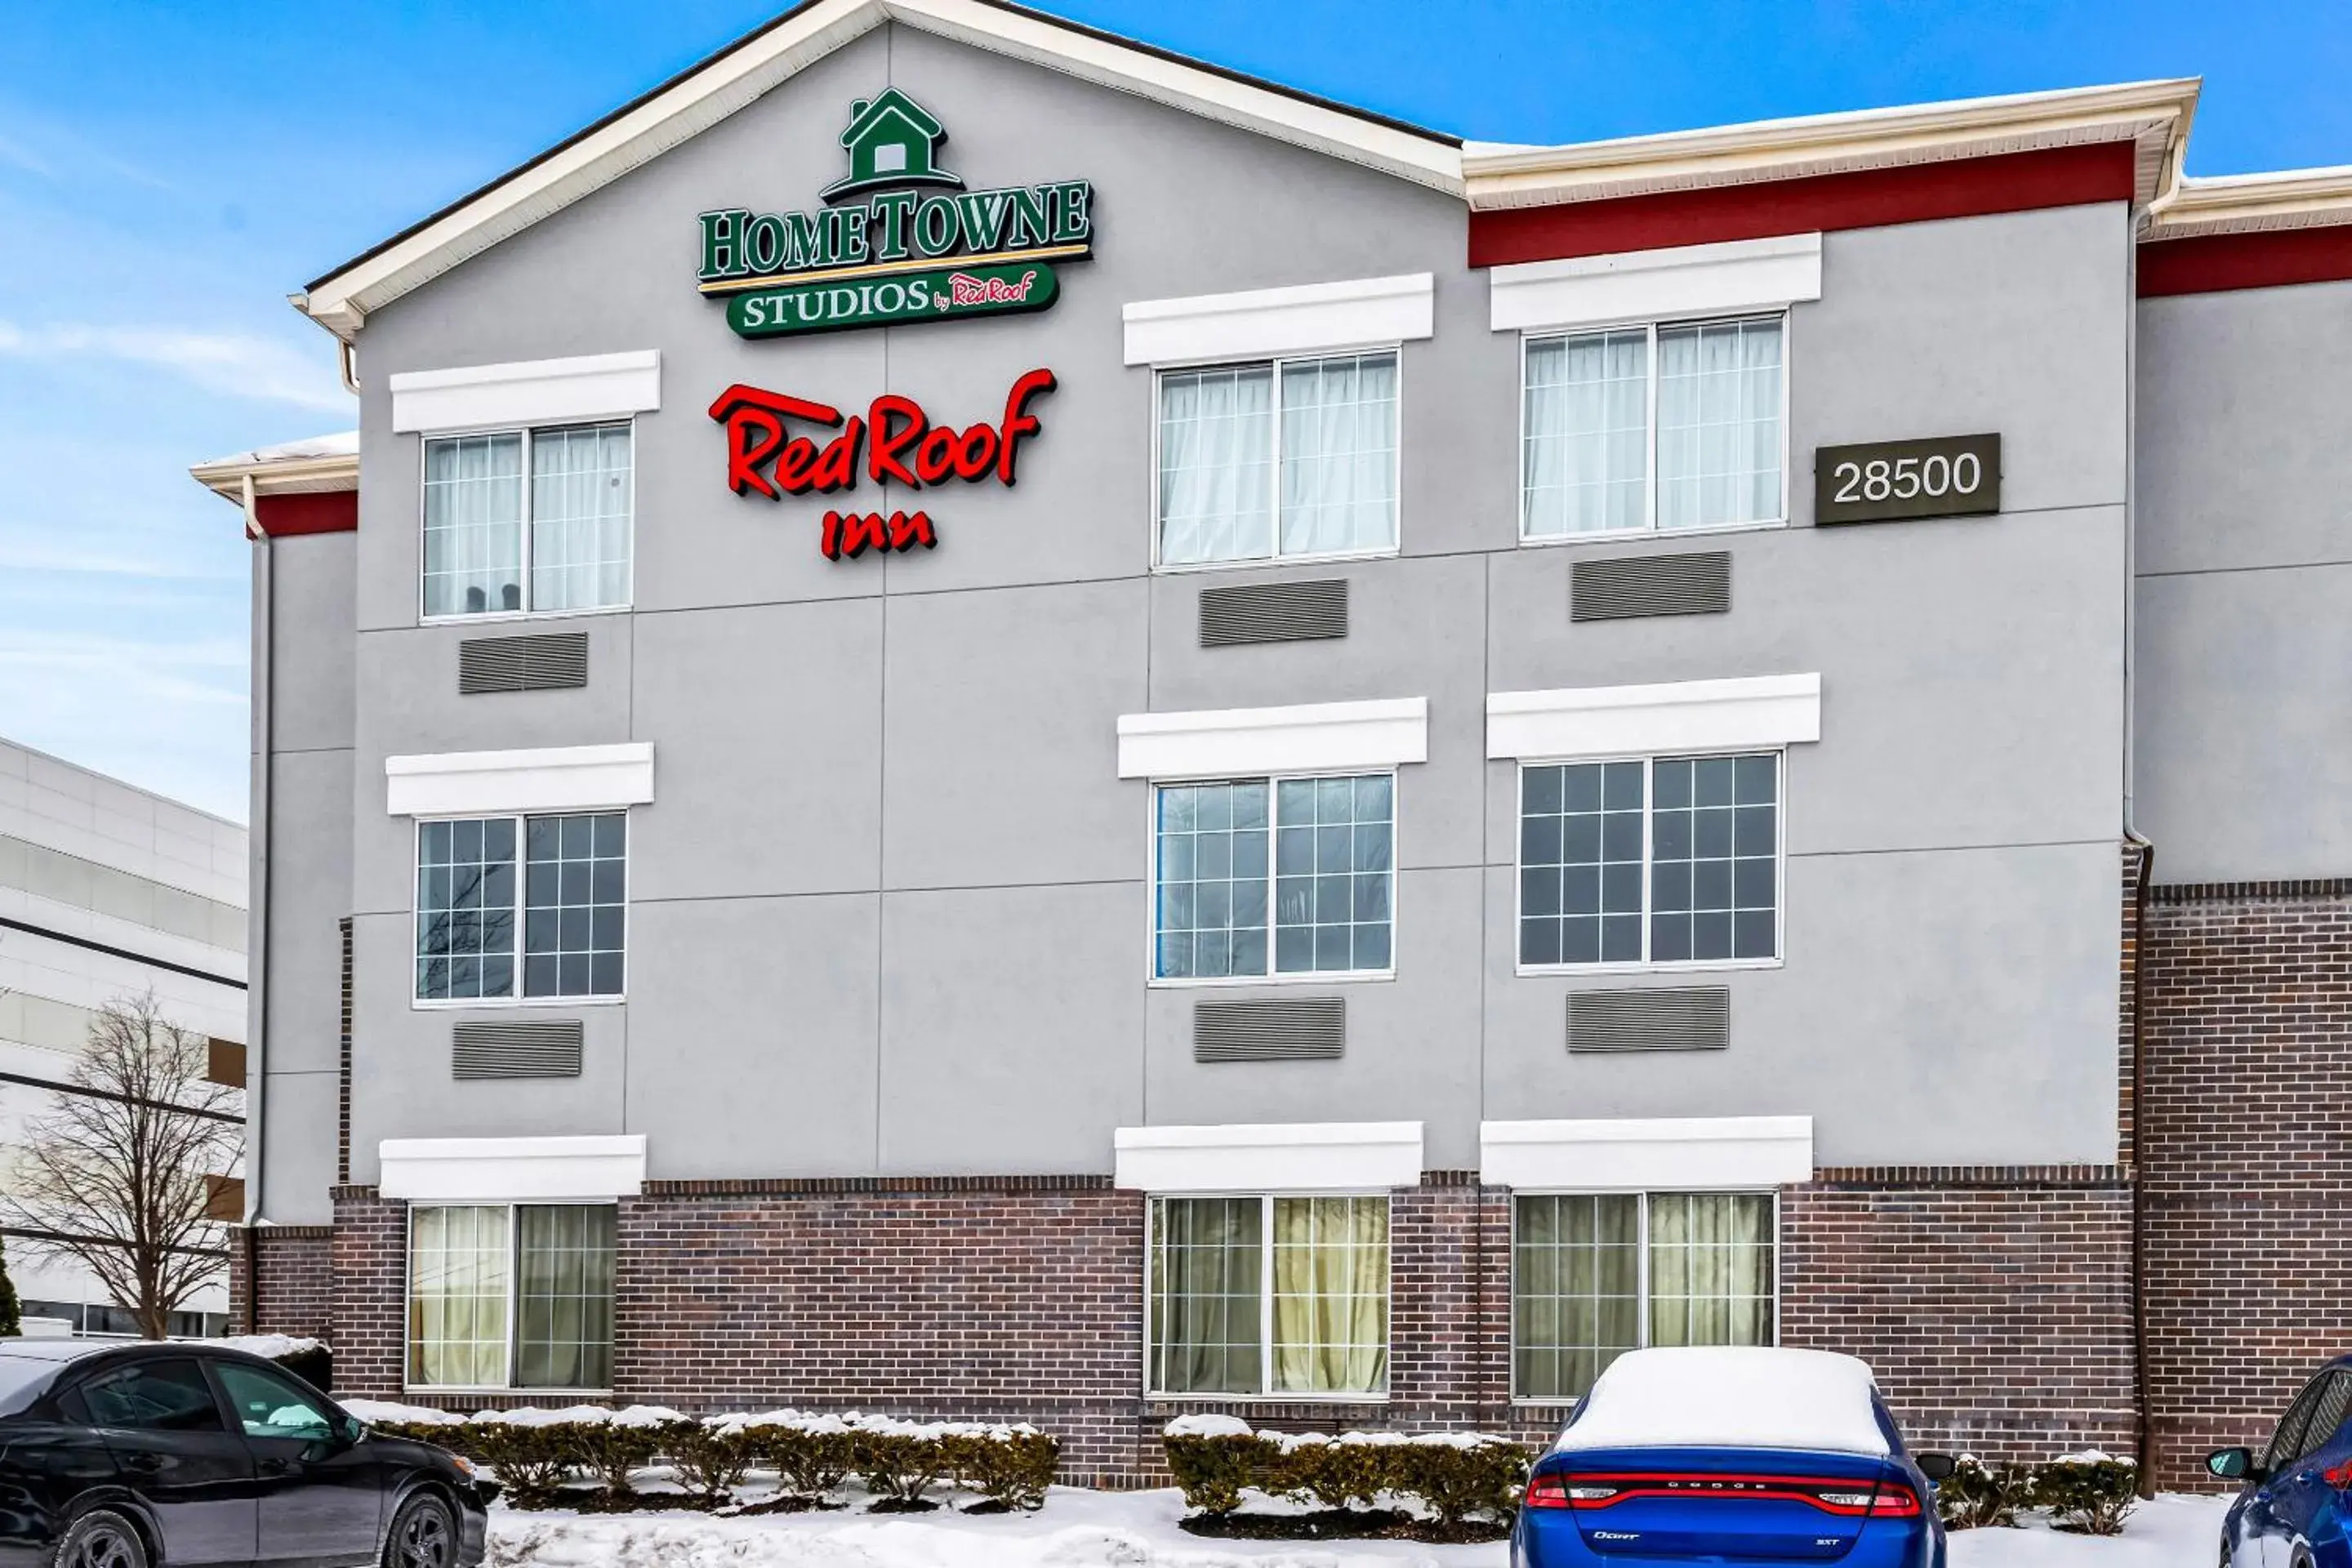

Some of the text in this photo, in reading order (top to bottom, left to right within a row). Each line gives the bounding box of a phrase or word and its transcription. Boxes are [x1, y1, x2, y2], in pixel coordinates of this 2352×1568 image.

[743, 280, 929, 327] STUDIOS
[934, 292, 950, 312] by
[1834, 452, 1981, 503] 28500
